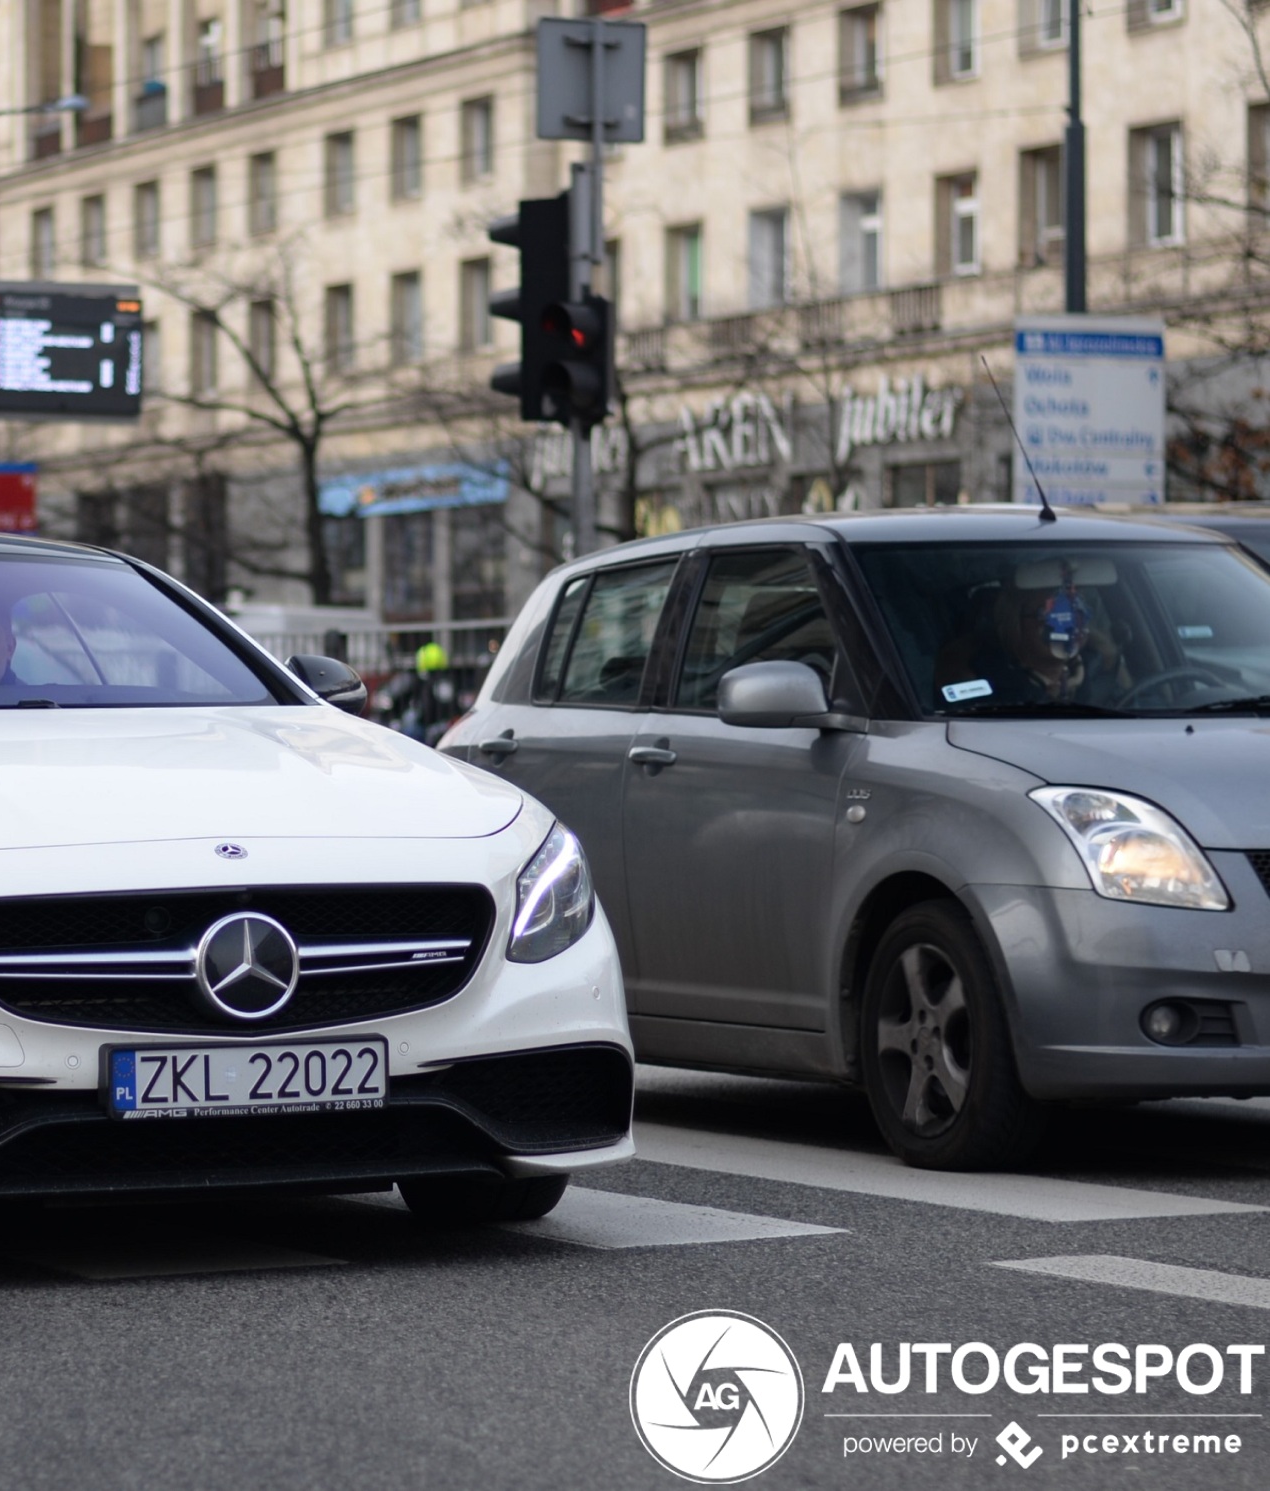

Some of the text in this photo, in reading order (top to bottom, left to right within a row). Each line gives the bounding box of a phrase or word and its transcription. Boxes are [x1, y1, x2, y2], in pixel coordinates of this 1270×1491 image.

[140, 1047, 380, 1103] ZKL 22022
[116, 1087, 134, 1100] PL
[142, 1099, 383, 1118] AMG Performance Center Autotrade 22 660 33 00
